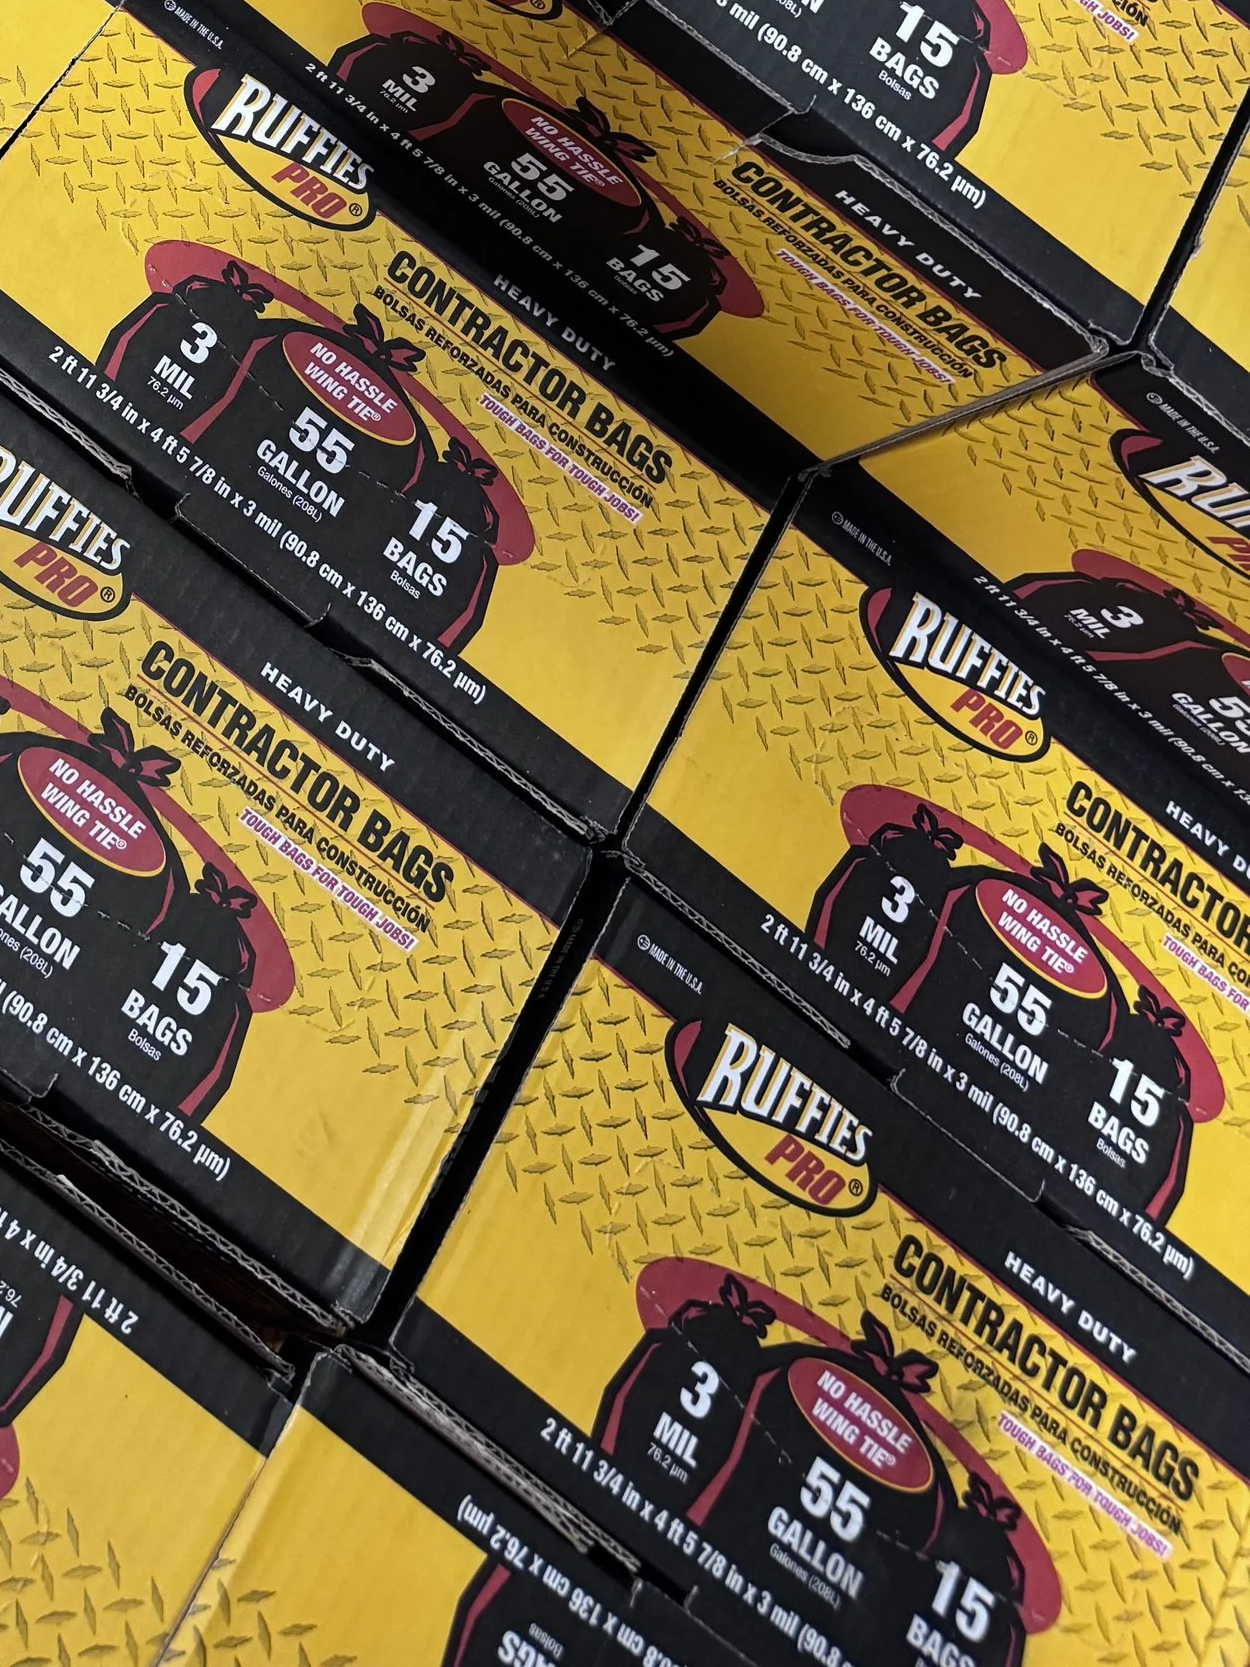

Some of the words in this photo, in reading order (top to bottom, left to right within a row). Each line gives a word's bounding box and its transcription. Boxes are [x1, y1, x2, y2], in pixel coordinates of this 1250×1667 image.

[210, 72, 375, 193] RUFFIES
[835, 190, 915, 247] HEAVY
[915, 252, 982, 299] DUTY
[153, 354, 196, 401] MIL
[180, 321, 218, 364] 3
[386, 249, 592, 421] CONTRACTOR
[584, 402, 673, 485] BAGS
[492, 273, 559, 328] HEAVY
[560, 326, 616, 373] DUTY
[371, 283, 426, 334] BOLSAS
[424, 325, 512, 400] REFORZADAS
[510, 392, 547, 429] PARA
[548, 422, 654, 510] CONSTRUCCIÓN
[382, 536, 447, 596] BAGS
[408, 499, 472, 563] 15
[888, 590, 1046, 719] RUFFIES
[141, 640, 367, 833] CONTRACTOR
[356, 808, 455, 903] BAGS
[260, 661, 334, 723] HEAVY
[334, 720, 396, 772] DUTY
[19, 837, 95, 918] 55
[240, 808, 282, 846] TOUGH
[278, 839, 314, 871] BAGS
[310, 865, 339, 892] FOR
[336, 884, 379, 922] TOUGH
[375, 917, 415, 950] JOBS!
[962, 1002, 1049, 1084] GALLON
[990, 962, 1053, 1036] 55
[1, 990, 49, 1035] (90.8
[45, 1027, 74, 1057] cm
[71, 1047, 88, 1068] x
[87, 1056, 121, 1091] 136
[118, 1084, 147, 1114] cm
[144, 1104, 160, 1124] x
[159, 1111, 198, 1153] 76.2
[696, 1021, 875, 1165] RUFFIES
[893, 1234, 1113, 1432] CONTRACTOR
[1107, 1403, 1200, 1502] BAGS
